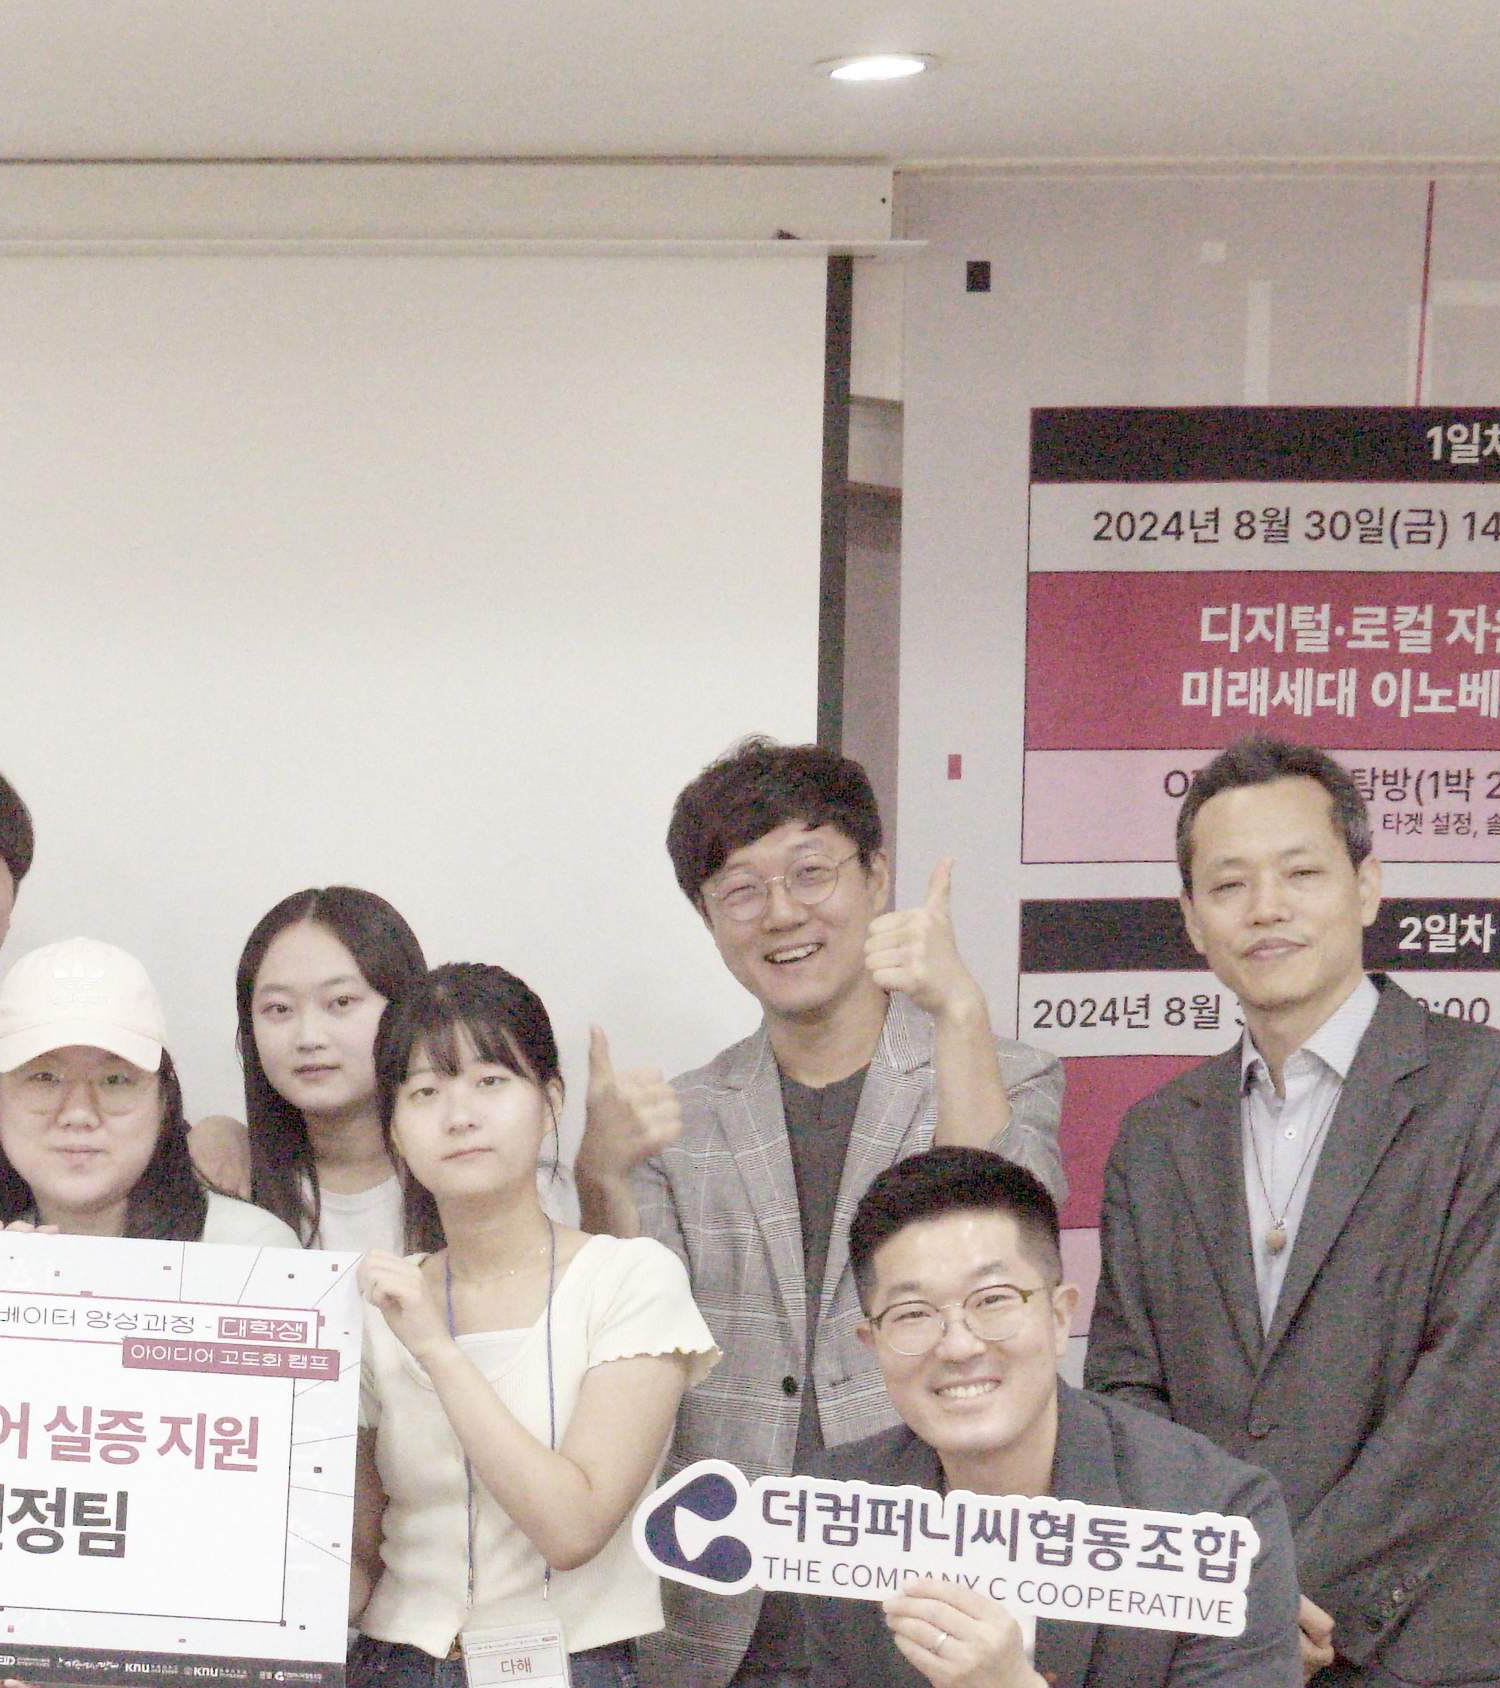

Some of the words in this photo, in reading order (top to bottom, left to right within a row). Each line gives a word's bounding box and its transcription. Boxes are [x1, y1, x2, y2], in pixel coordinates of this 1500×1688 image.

[1092, 509, 1222, 545] 2024년
[1234, 508, 1292, 545] 8월
[1304, 508, 1448, 550] 30일(금)
[1181, 671, 1357, 718] 미래세대
[1382, 815, 1423, 835] 타겟
[1432, 813, 1478, 838] 설정,
[1399, 914, 1496, 956] 2일차
[1033, 997, 1152, 1030] 2024년
[1163, 995, 1223, 1029] 8월
[86, 1309, 196, 1334] 양성과정
[220, 1317, 304, 1341] 대학생
[131, 1344, 213, 1364] 아이디어
[220, 1348, 283, 1367] 고도화
[289, 1352, 330, 1371] 캠프
[43, 1406, 147, 1465] 실증
[158, 1413, 259, 1472] 지원
[762, 1488, 1245, 1585] 더컴퍼니씨협동조합
[762, 1555, 821, 1585] THE
[831, 1563, 981, 1591] COMY
[990, 1578, 1006, 1601] C
[1018, 1580, 1233, 1625] COOPERATIVE
